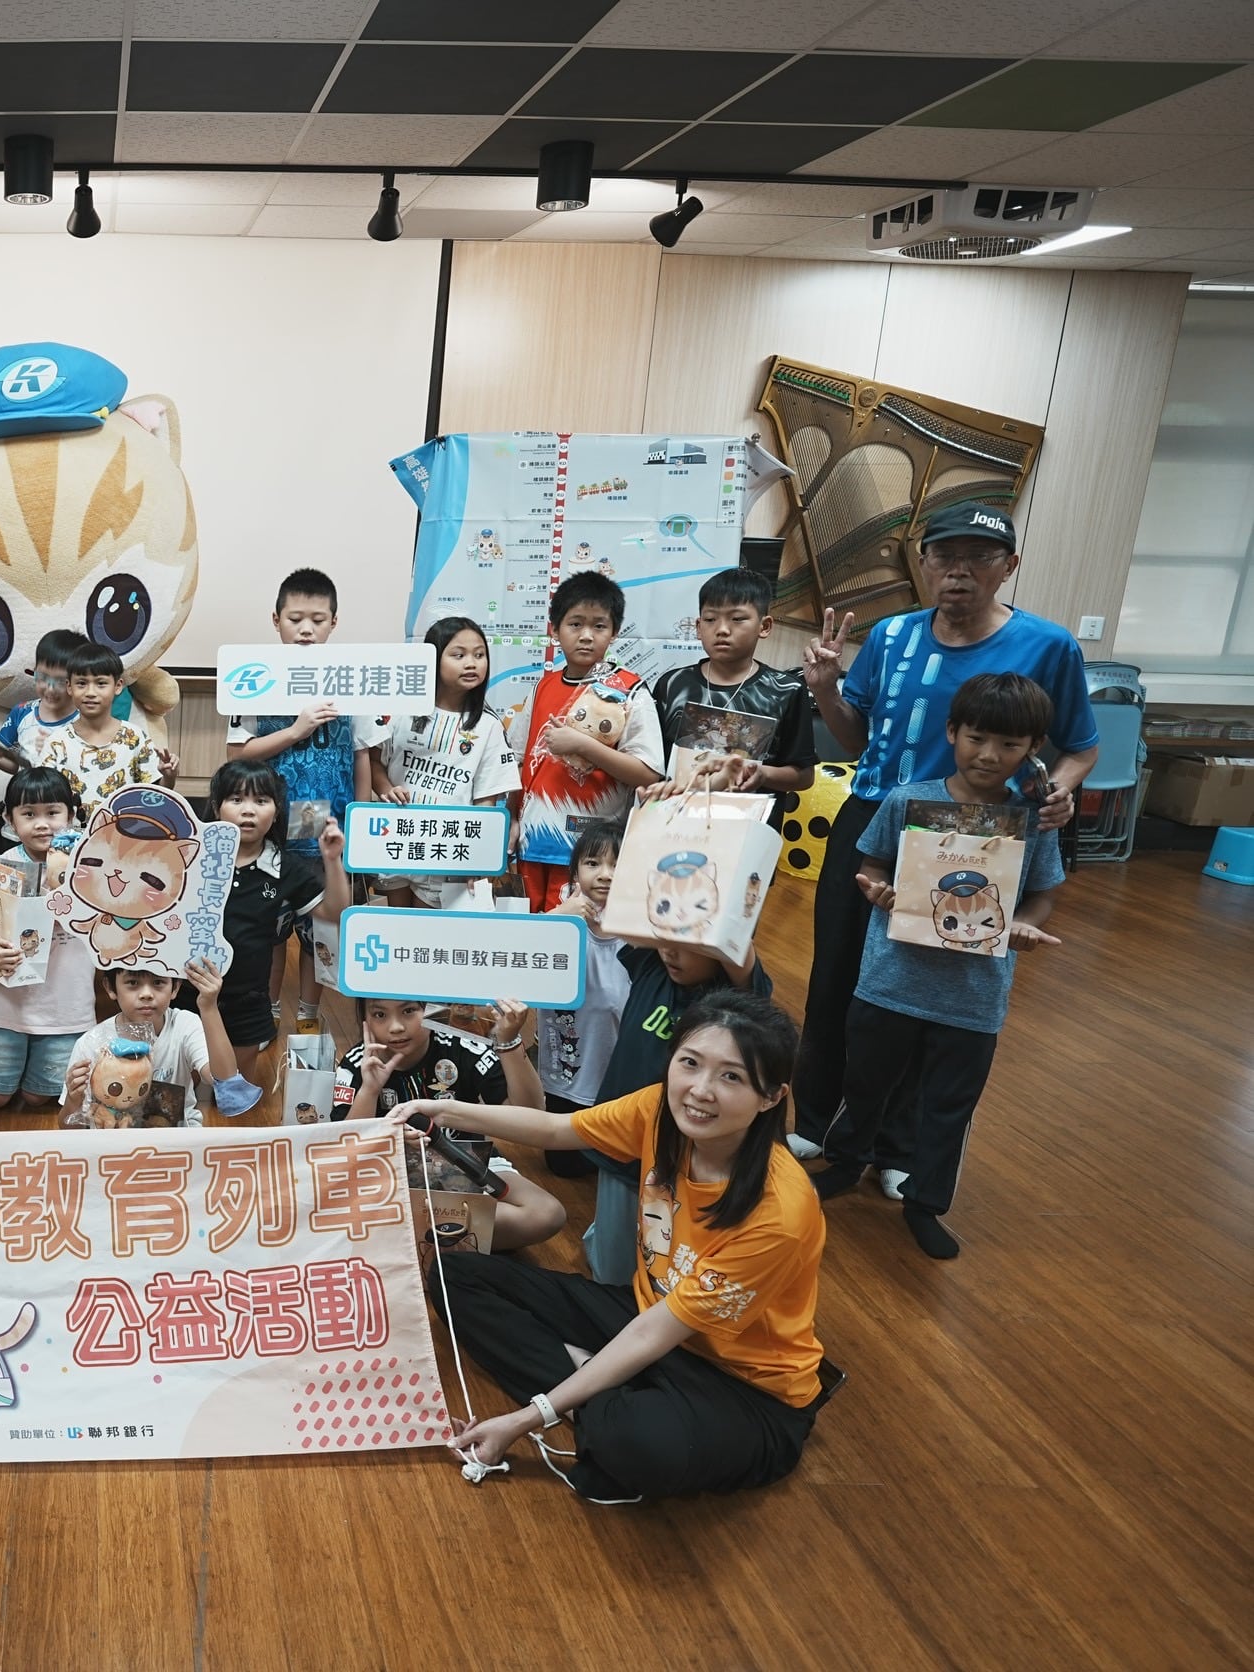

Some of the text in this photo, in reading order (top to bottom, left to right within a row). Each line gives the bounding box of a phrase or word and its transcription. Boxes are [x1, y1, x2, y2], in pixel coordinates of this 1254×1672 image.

[286, 664, 428, 697] 高雄捷運
[402, 749, 472, 784] Emirates
[404, 769, 457, 796] FLY BETTER
[396, 818, 483, 840] 聯邦減碳
[385, 841, 470, 862] 守護未來
[393, 946, 570, 971] 中鋼集團教育基金會
[65, 1256, 389, 1368] 公益活動
[87, 1424, 155, 1439] 聯邦銀行
